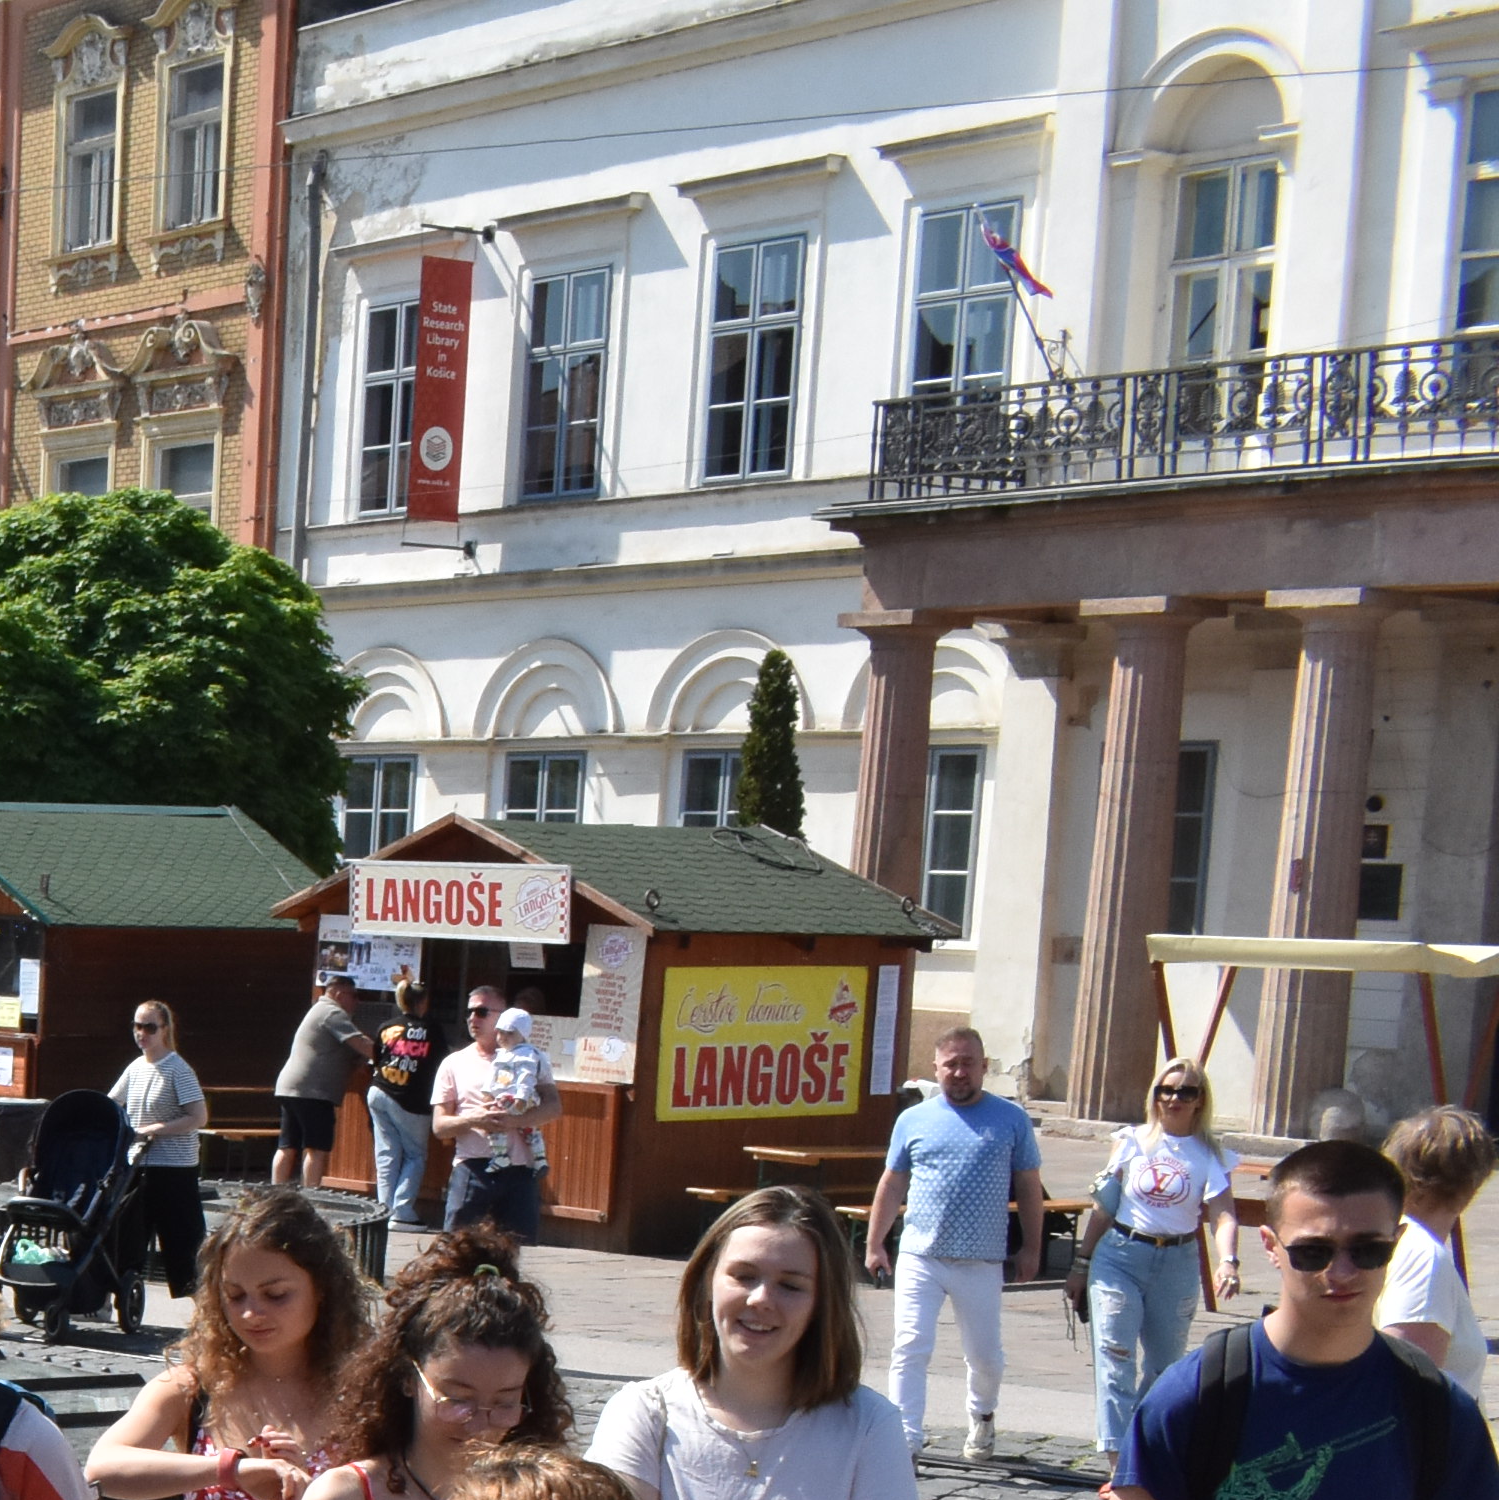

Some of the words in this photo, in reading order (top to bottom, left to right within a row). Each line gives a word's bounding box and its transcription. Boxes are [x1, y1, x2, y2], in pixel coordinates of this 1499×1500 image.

[432, 301, 458, 315] State
[423, 316, 465, 332] Research
[426, 333, 460, 350] Library
[437, 350, 447, 362] in
[426, 365, 457, 380] Košice
[365, 872, 503, 927] LANGOŠE
[745, 983, 806, 1024] domáce
[671, 1031, 850, 1108] LANGOŠE
